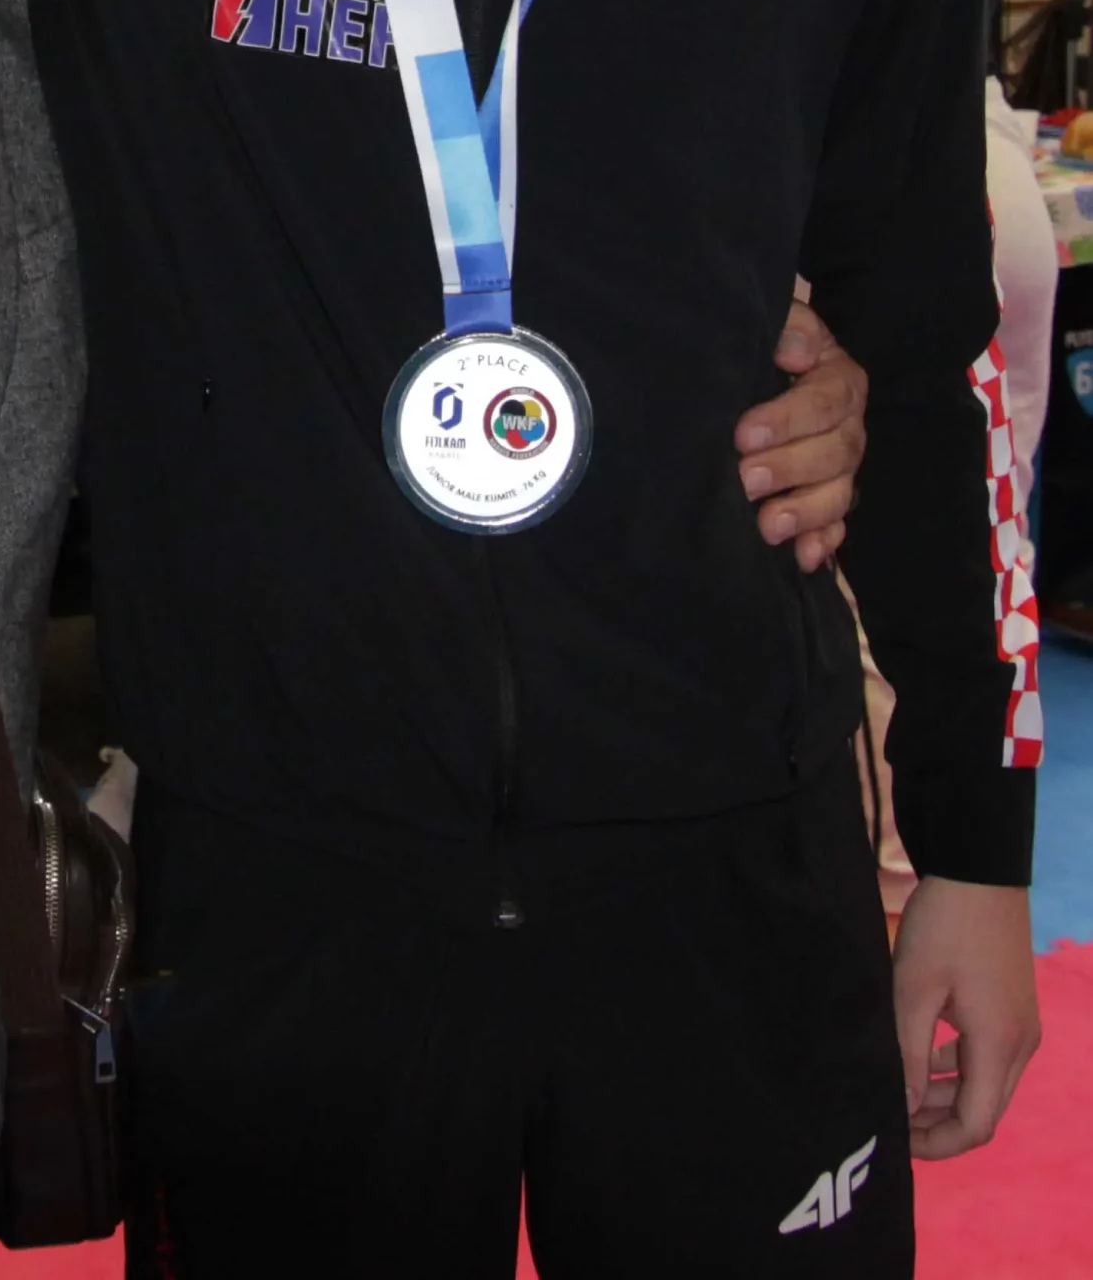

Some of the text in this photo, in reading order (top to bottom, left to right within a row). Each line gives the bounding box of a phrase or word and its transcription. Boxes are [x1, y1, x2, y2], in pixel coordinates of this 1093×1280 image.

[477, 354, 529, 377] PLACE
[502, 415, 541, 431] WKF
[425, 435, 467, 449] FIJLKAM
[456, 488, 483, 502] MALE
[484, 488, 518, 503] KUMITE
[778, 1134, 877, 1235] 4F
